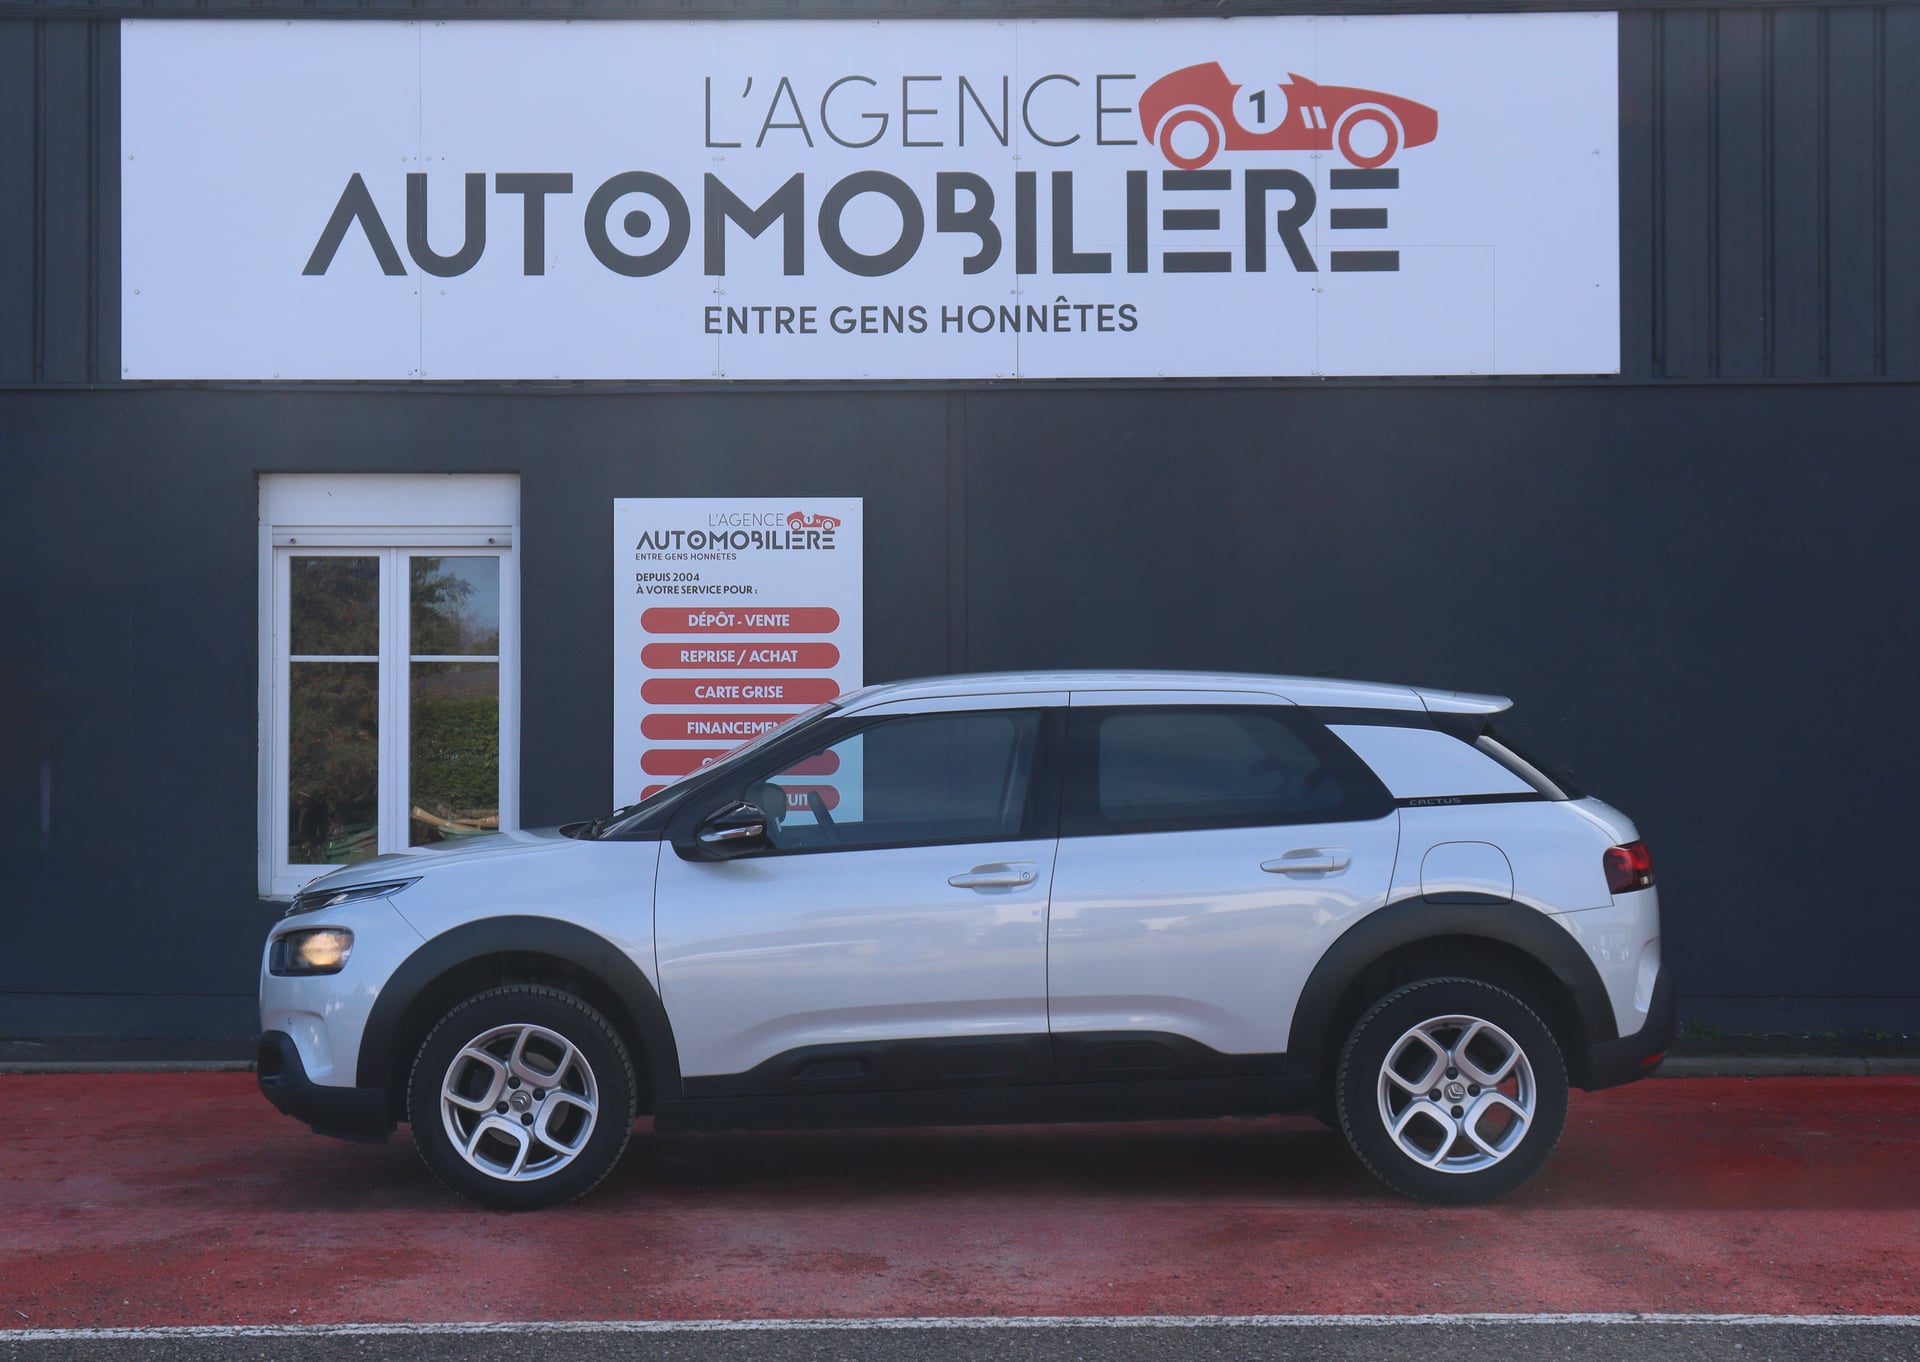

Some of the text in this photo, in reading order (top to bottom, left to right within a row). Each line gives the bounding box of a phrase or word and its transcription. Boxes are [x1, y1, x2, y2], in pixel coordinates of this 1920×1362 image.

[705, 74, 1138, 149] L'AGENCE
[1249, 90, 1266, 123] 1
[704, 296, 1138, 335] ENTRE GENS HONNÊTES
[708, 512, 785, 527] L'AGENCE
[635, 553, 662, 561] ENTRE
[664, 553, 688, 561] GENS
[635, 572, 700, 582] DEPUIS 2004
[635, 583, 644, 595] À
[645, 585, 680, 595] VOTRE
[680, 585, 722, 595] SERVICE
[723, 585, 753, 595] POUR
[688, 611, 735, 627] DÉPÔT
[745, 614, 790, 627] VENTE
[680, 650, 735, 663] REPRISE
[748, 650, 798, 663] ACHAT
[694, 685, 783, 699] CARTE GRISE
[687, 721, 780, 734] FINANCEME
[1409, 797, 1461, 806] CACTUS
